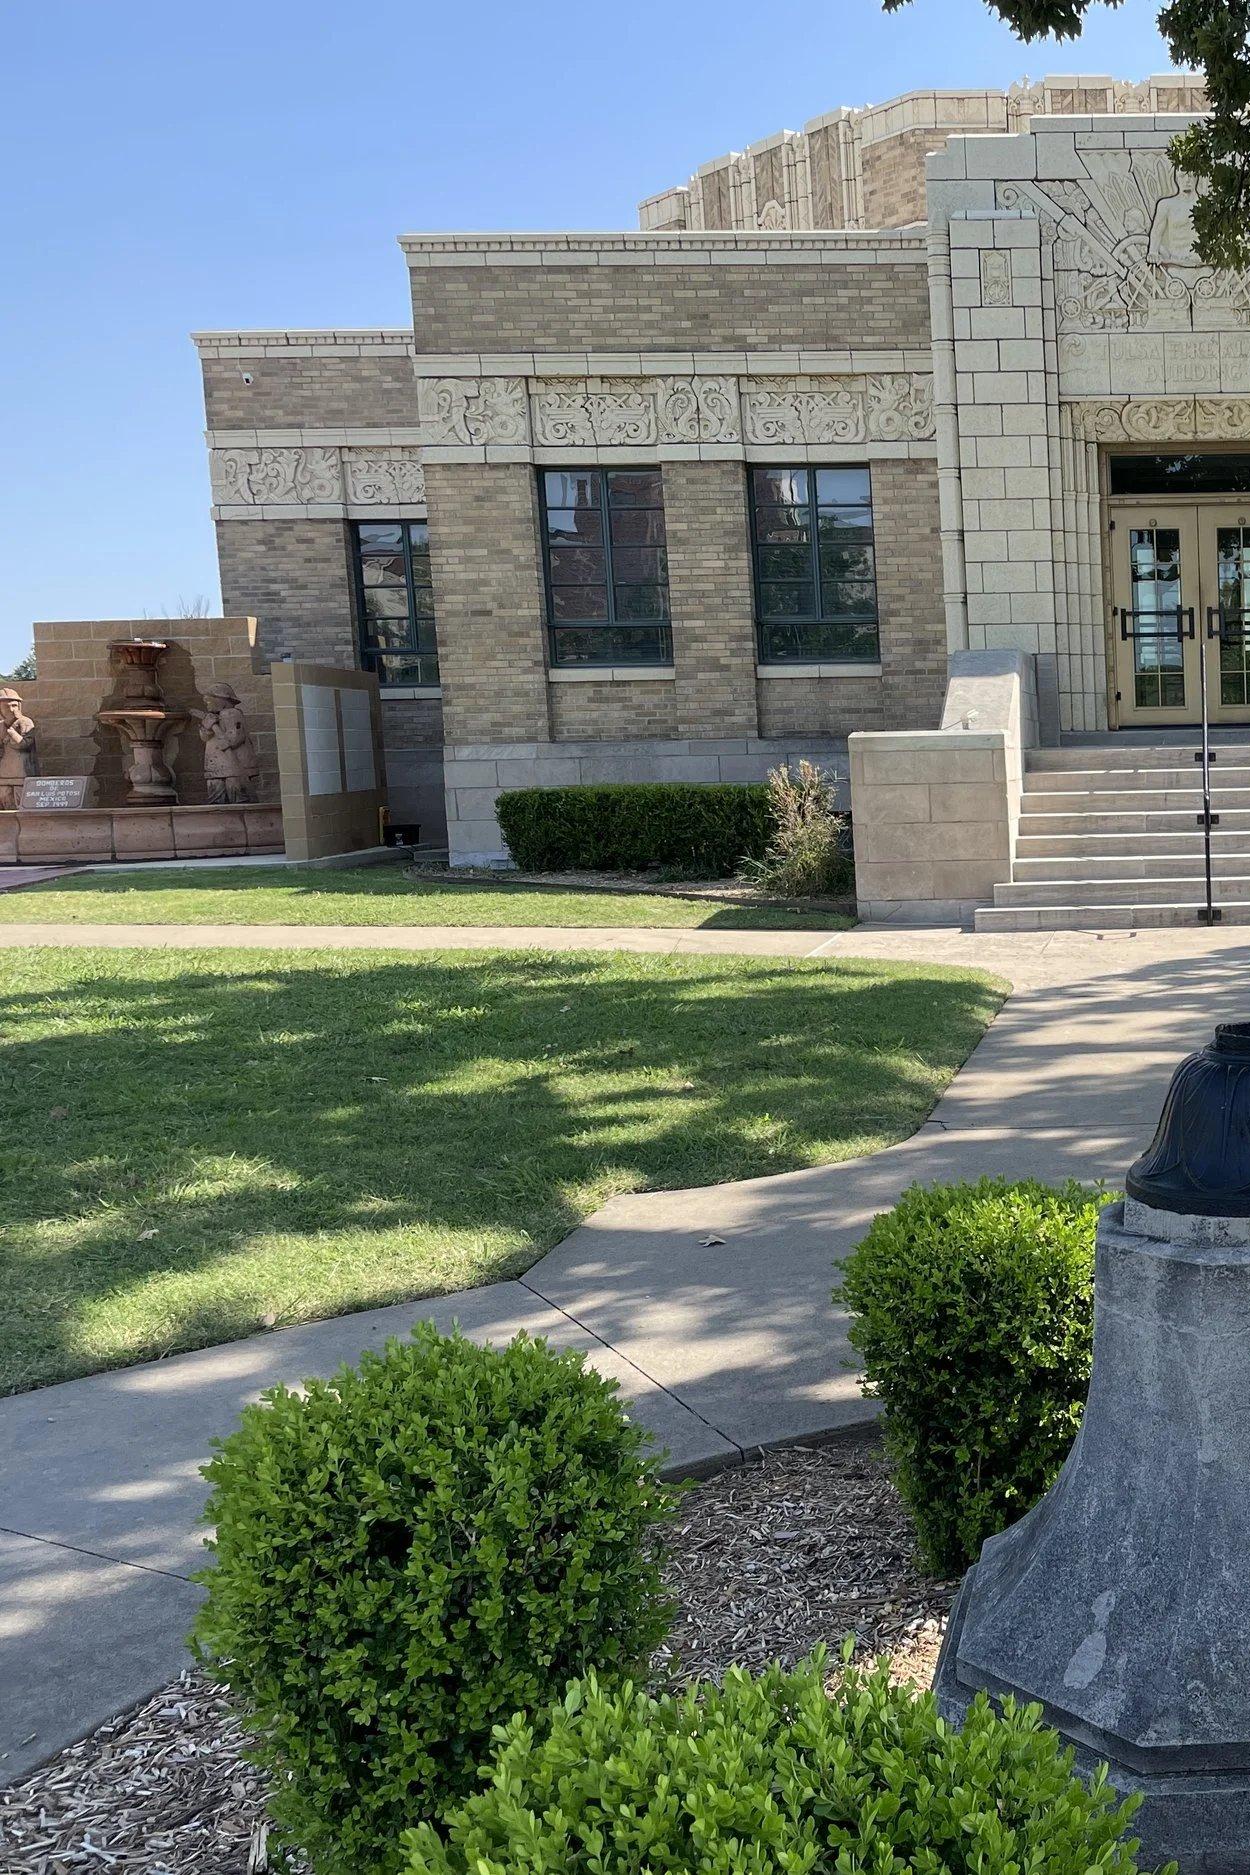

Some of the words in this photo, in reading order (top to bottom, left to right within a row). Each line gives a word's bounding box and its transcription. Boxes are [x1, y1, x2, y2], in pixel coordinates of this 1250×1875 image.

[1096, 341, 1162, 360] TULSA
[1166, 340, 1218, 360] FIRE
[1145, 363, 1243, 383] BUILDING
